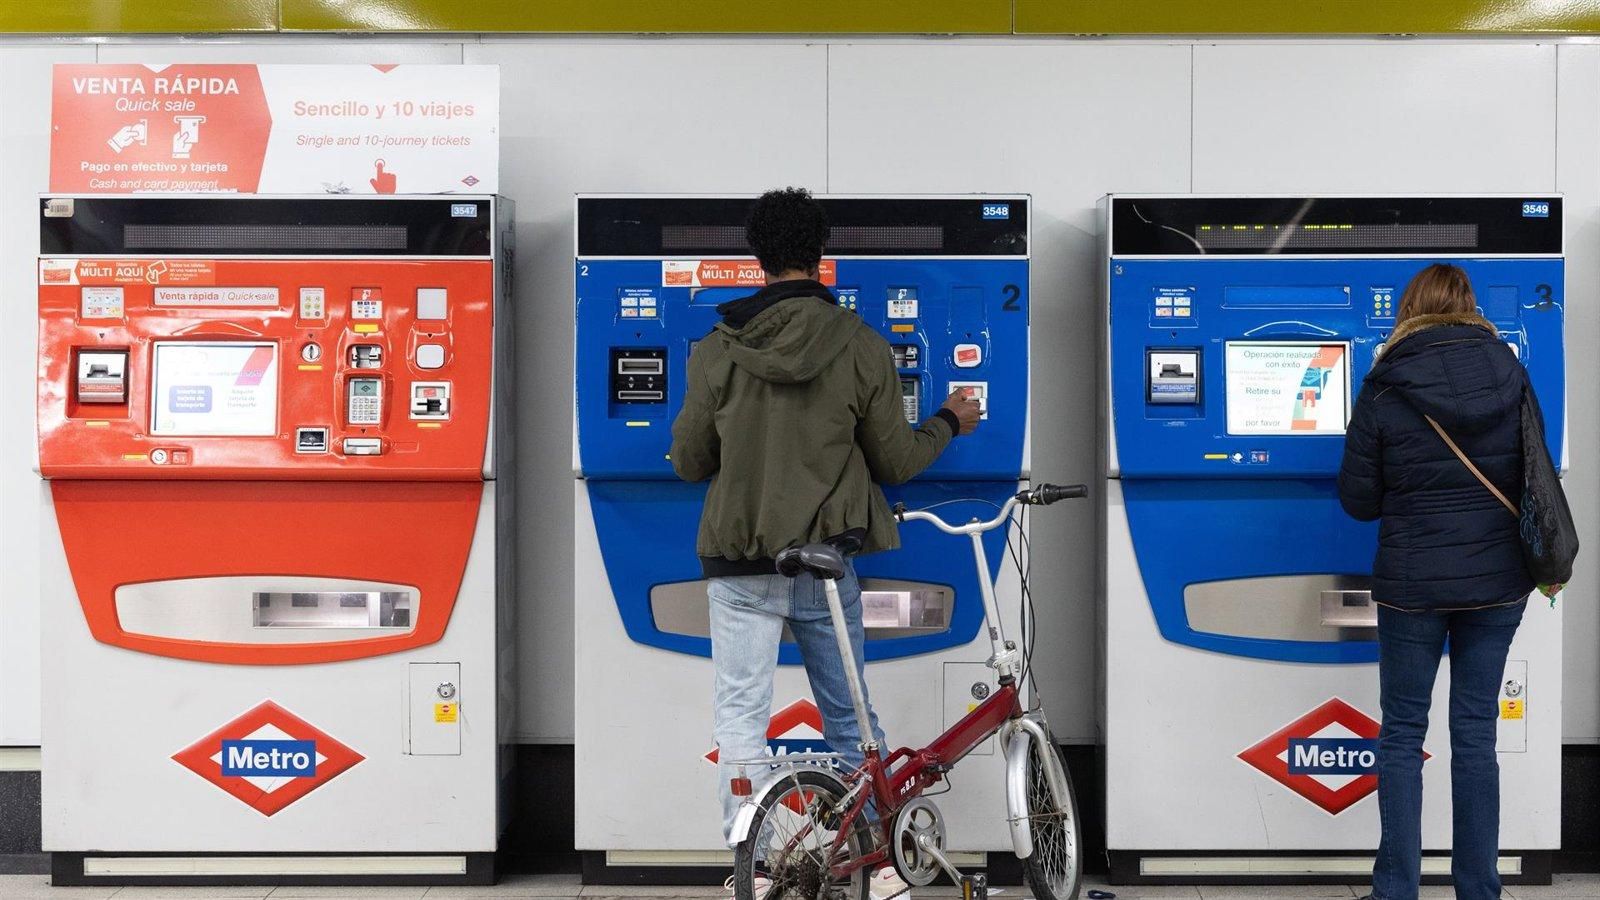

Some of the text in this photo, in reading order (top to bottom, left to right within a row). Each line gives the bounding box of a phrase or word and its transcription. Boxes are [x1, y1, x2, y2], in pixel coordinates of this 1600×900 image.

[73, 74, 240, 94] VENTA RÁPIDA
[115, 98, 196, 112] Quick sale
[294, 101, 475, 119] Sencillo y 10 viajes
[296, 135, 471, 148] Single and 10-journey tickets
[81, 161, 229, 174] Pago en efectivo y tarjeta
[89, 178, 218, 191] Cash and card payment
[453, 206, 475, 215] 3547
[983, 207, 1008, 216] 3548
[1523, 205, 1548, 214] 3549
[80, 267, 113, 277] MULTI
[580, 265, 589, 276] 2
[702, 269, 734, 279] MULTI
[159, 292, 186, 300] Venta
[188, 291, 219, 301] rápida
[227, 291, 254, 301] Quick
[256, 291, 275, 301] sale
[1001, 284, 1021, 311] 2
[1535, 284, 1553, 311] 3
[1243, 350, 1322, 359] Operación realizada
[1245, 387, 1269, 395] Retire
[1260, 419, 1281, 427] favor
[228, 747, 310, 770] Metro
[1294, 745, 1376, 768] Metro
